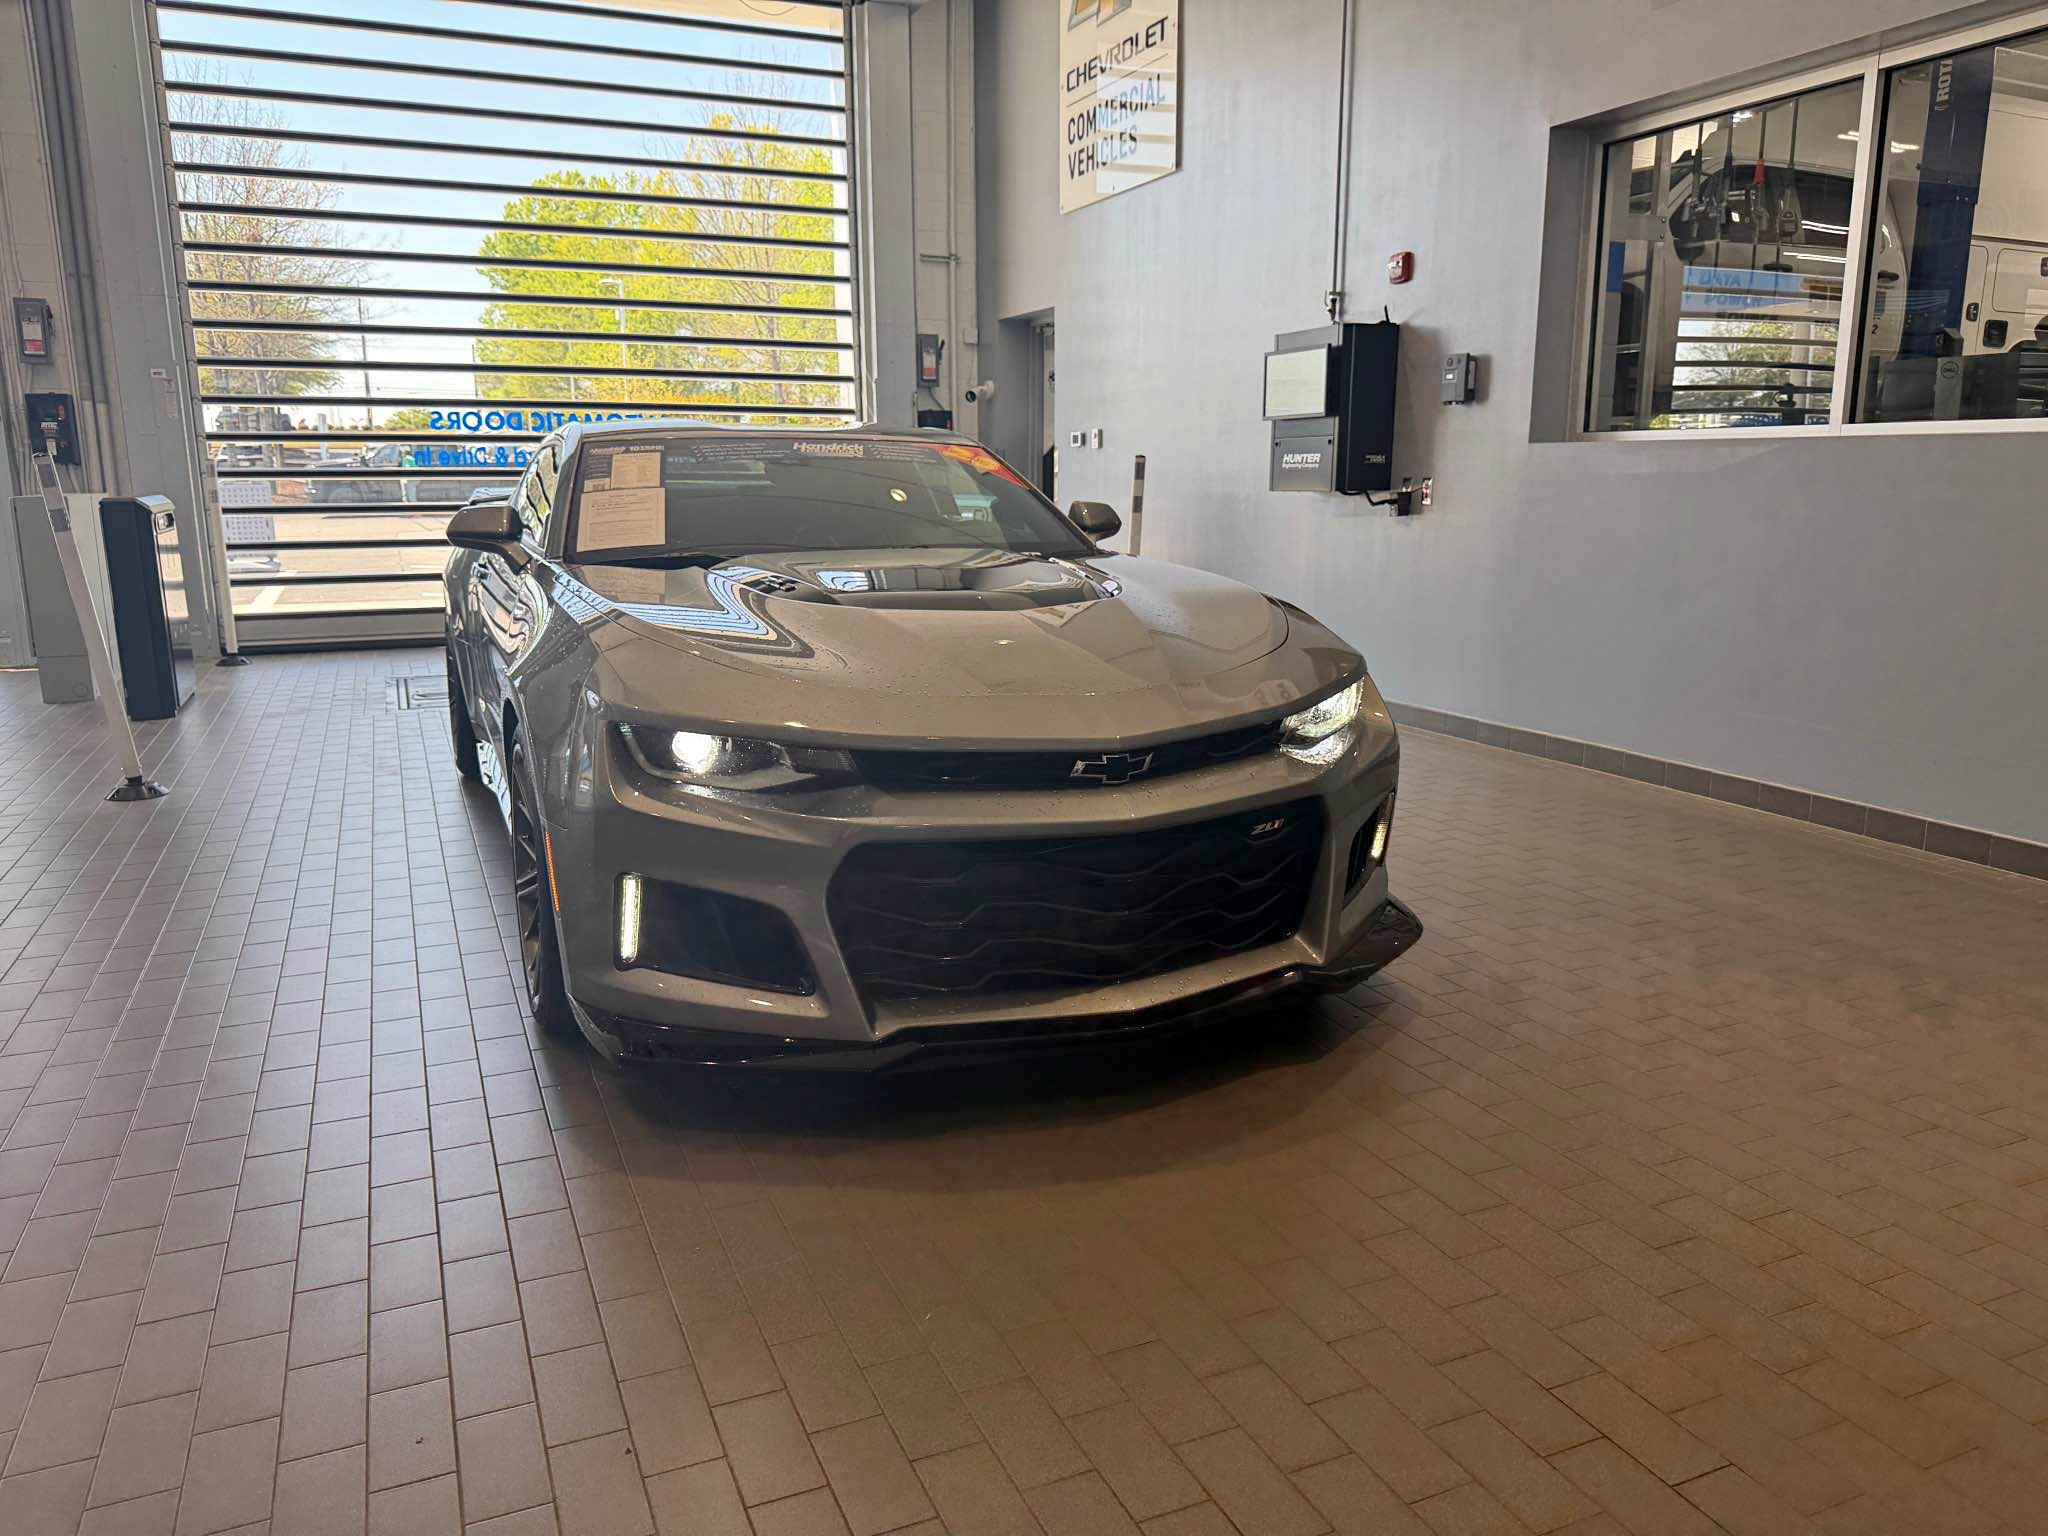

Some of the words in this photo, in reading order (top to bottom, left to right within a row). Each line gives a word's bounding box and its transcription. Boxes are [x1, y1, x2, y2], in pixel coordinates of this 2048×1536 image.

[1066, 16, 1168, 93] CHEVROLET
[1067, 73, 1166, 145] COMMERCIAL
[1067, 125, 1138, 180] VEHICLES
[1283, 453, 1321, 463] HUNTER
